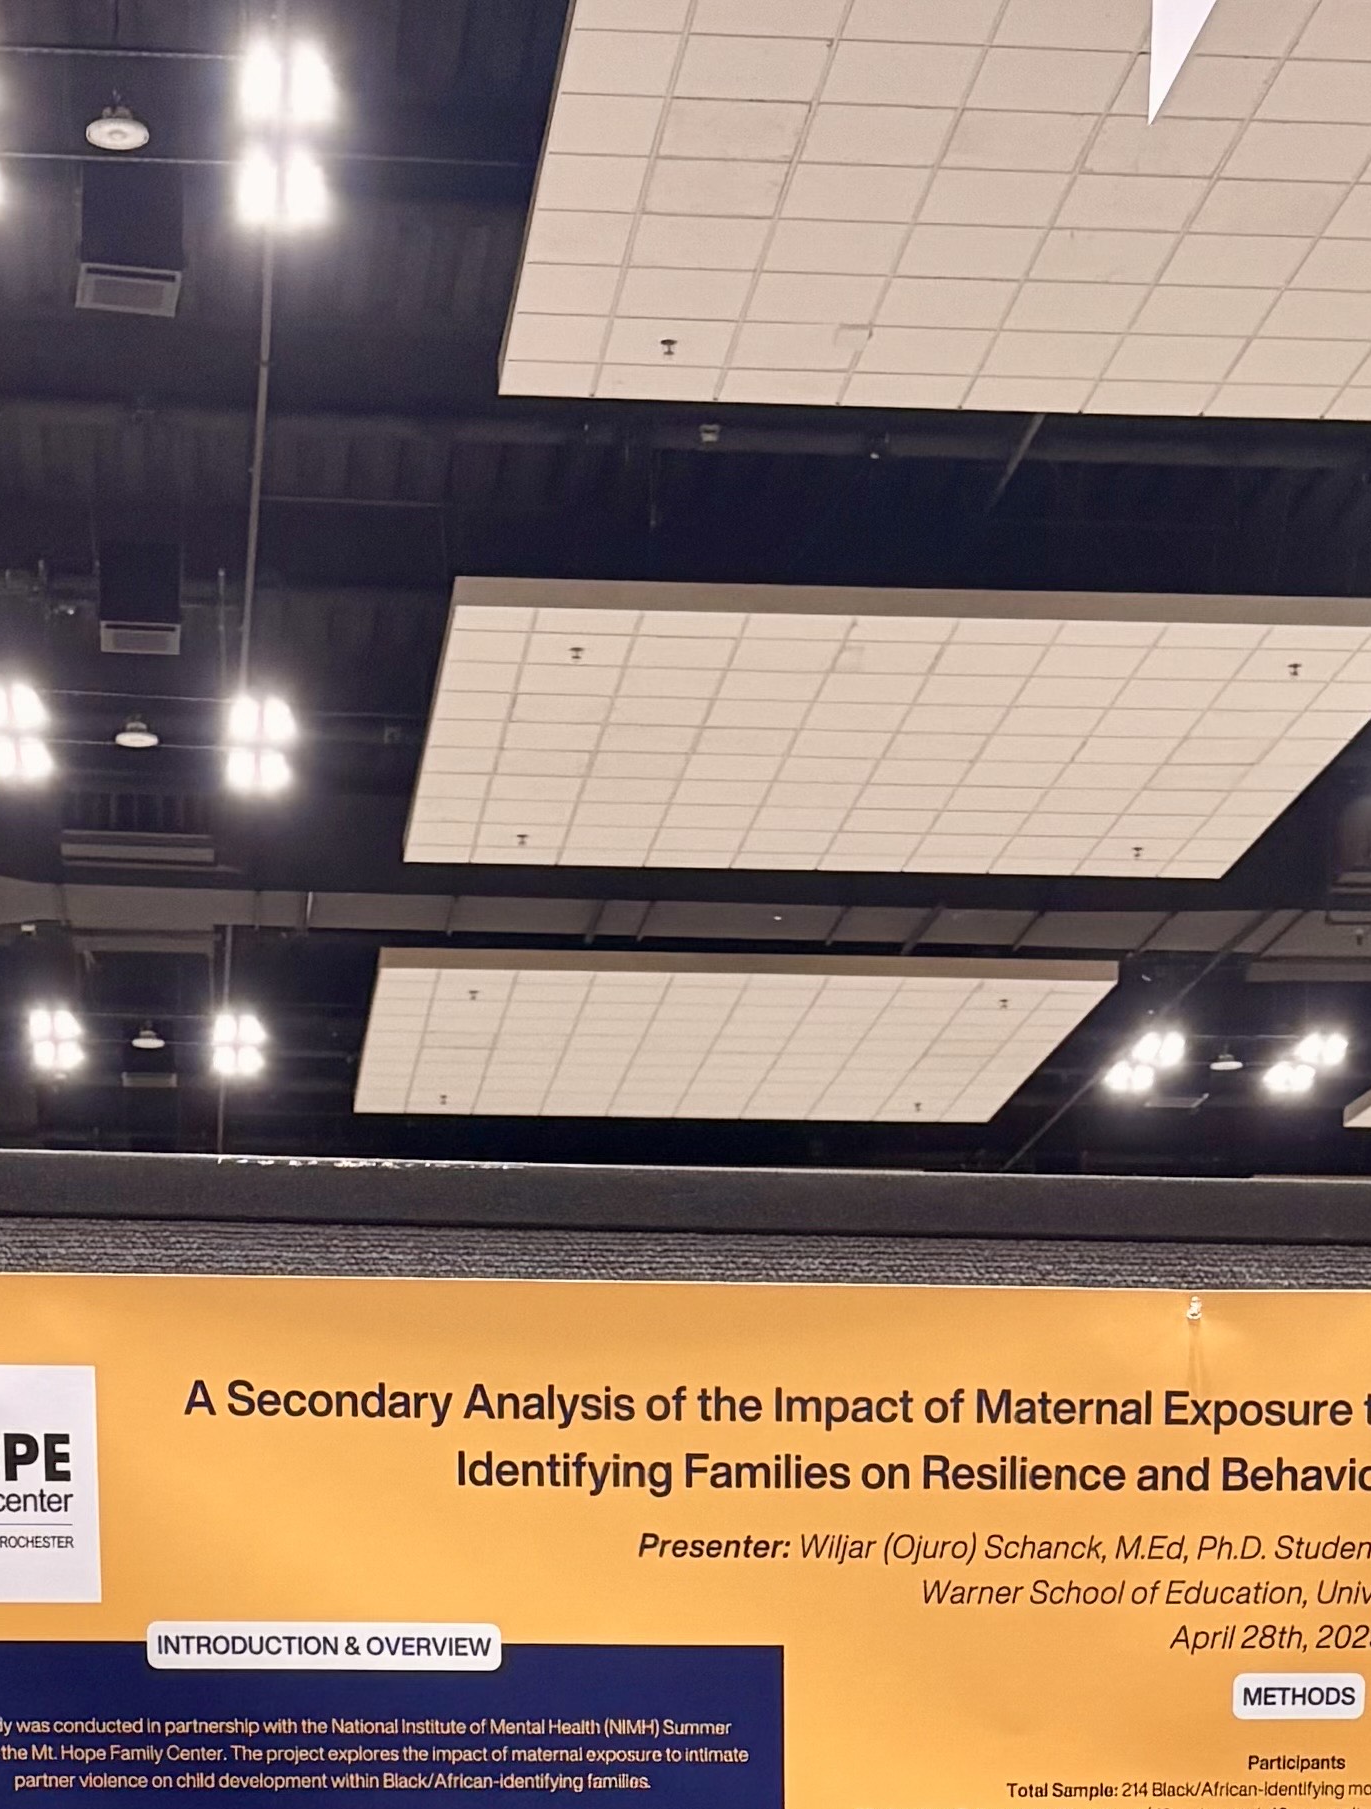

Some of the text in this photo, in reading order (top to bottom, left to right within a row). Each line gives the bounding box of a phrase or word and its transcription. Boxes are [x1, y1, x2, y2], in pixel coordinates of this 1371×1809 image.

[184, 1379, 216, 1415] A
[227, 1379, 453, 1427] Secondary
[462, 1383, 635, 1429] Analysis
[646, 1385, 686, 1421] of
[696, 1385, 762, 1422] the
[775, 1386, 913, 1431] Impact
[924, 1387, 964, 1423] of
[976, 1388, 1152, 1425] Maternal
[1164, 1390, 1353, 1434] Exposure
[457, 1450, 671, 1497] Identifying
[685, 1452, 850, 1489] Families
[861, 1462, 909, 1489] on
[923, 1454, 1126, 1491] Resilience
[1136, 1456, 1209, 1491] and
[0, 1535, 74, 1548] ROCHESTER
[638, 1532, 790, 1558] Presenter:
[800, 1533, 877, 1564] Wiljar
[883, 1531, 976, 1565] (Ojuro)
[984, 1533, 1106, 1563] Schanck,
[1115, 1534, 1188, 1564] M.Ed,
[1196, 1535, 1265, 1560] Ph.D.
[923, 1579, 1024, 1604] Warner
[1029, 1579, 1125, 1604] School
[1131, 1579, 1161, 1604] of
[1165, 1579, 1307, 1608] Education,
[157, 1634, 491, 1656] INTRODUCTION & OVERVIEW
[1169, 1624, 1236, 1655] April
[1240, 1624, 1307, 1653] 28th,
[1243, 1686, 1355, 1706] METHODS
[15, 1720, 50, 1732] was
[53, 1717, 143, 1733] conducted
[147, 1717, 161, 1733] in
[164, 1717, 259, 1737] partnership
[262, 1717, 297, 1733] with
[301, 1718, 328, 1733] the
[331, 1717, 398, 1734] National
[401, 1718, 466, 1734] Institute
[469, 1718, 487, 1734] of
[490, 1718, 545, 1734] Mental
[548, 1718, 600, 1734] Health
[604, 1717, 659, 1738] (NIMH)
[662, 1718, 732, 1735] Summer
[1248, 1754, 1345, 1773] Participants
[1006, 1782, 1048, 1798] Total
[1051, 1782, 1118, 1801] Sample:
[1121, 1781, 1148, 1797] 214
[1152, 1780, 1344, 1799] Black/African-identifying
